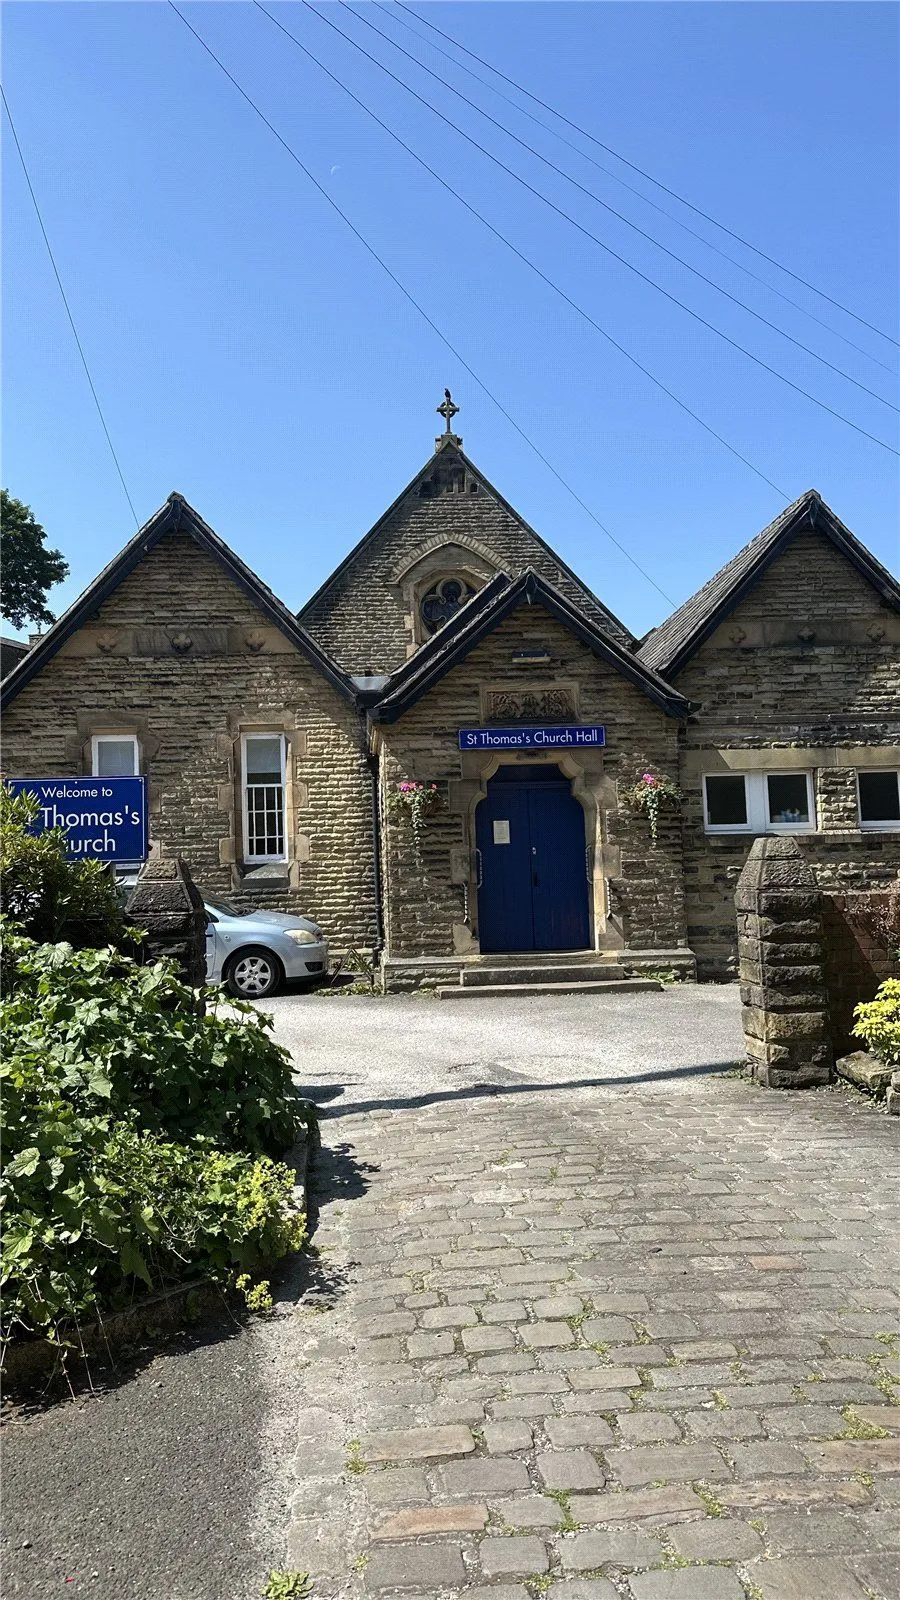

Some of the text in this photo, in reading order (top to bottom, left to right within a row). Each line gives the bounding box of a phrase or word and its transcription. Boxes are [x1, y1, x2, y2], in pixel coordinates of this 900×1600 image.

[466, 729, 598, 745] St Thomas's Church Hall
[41, 785, 113, 798] Welcome to
[40, 804, 140, 828] Thomas's
[62, 829, 116, 853] urch
